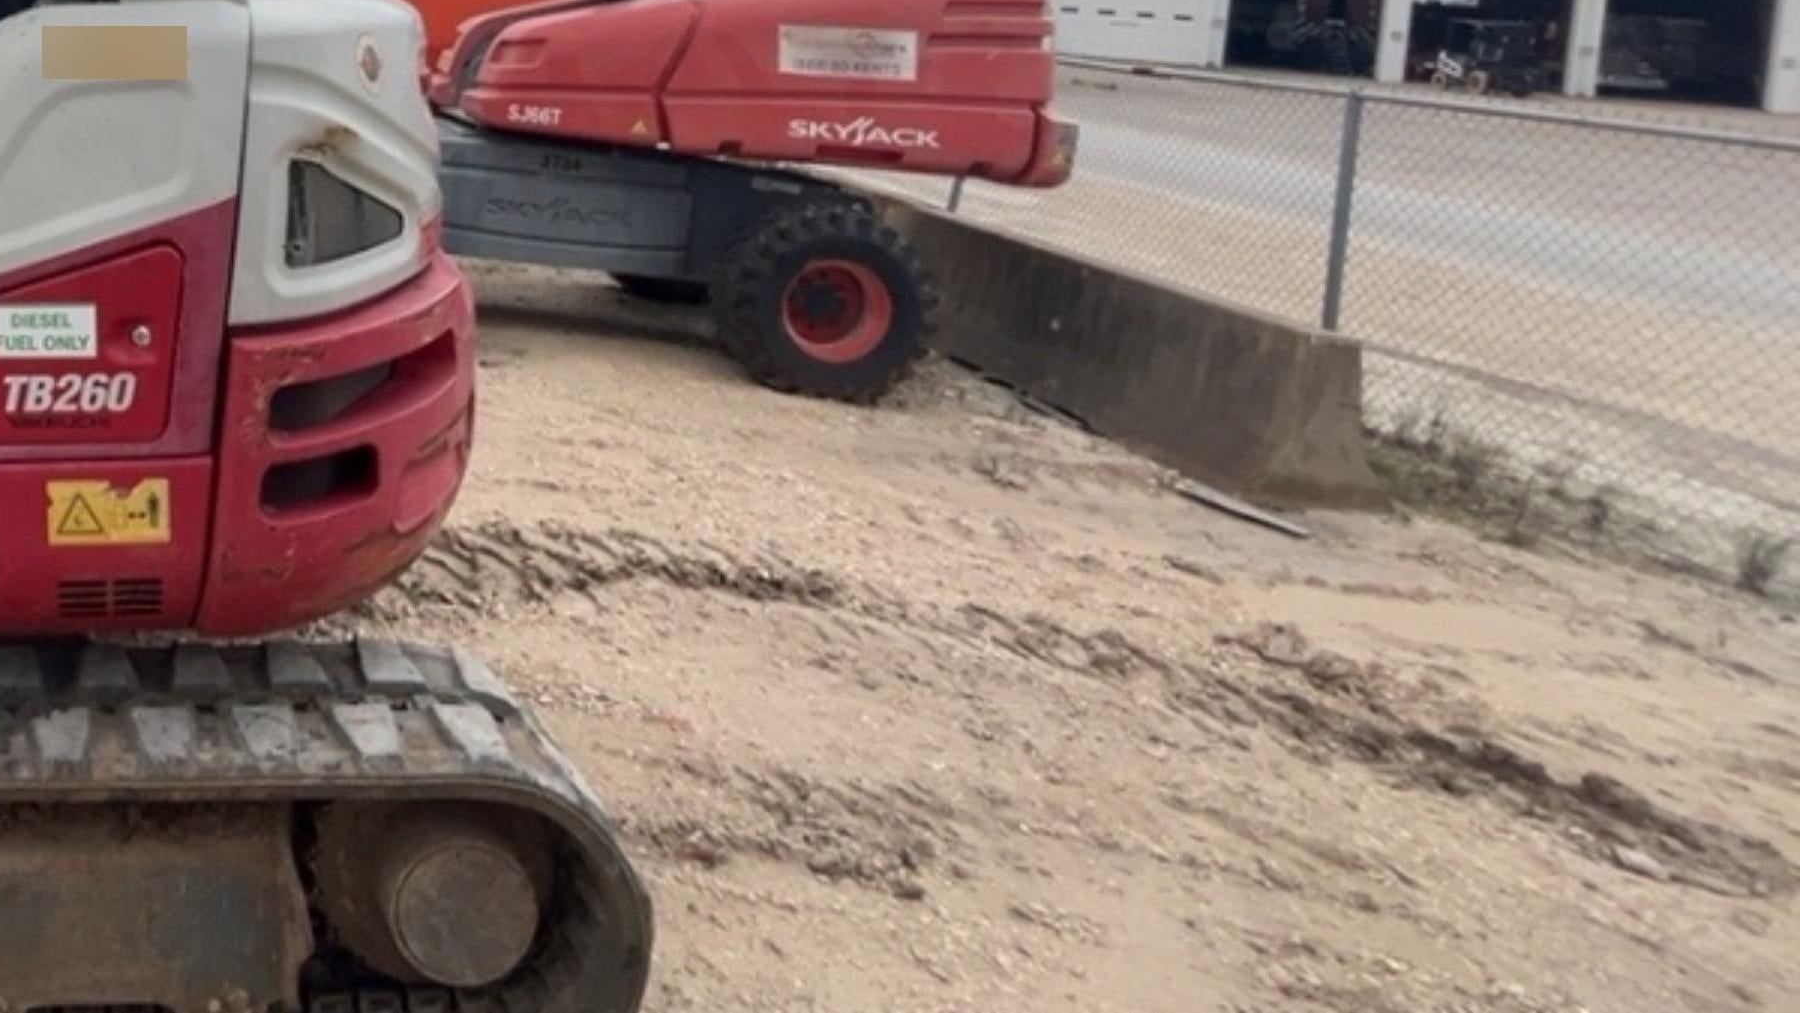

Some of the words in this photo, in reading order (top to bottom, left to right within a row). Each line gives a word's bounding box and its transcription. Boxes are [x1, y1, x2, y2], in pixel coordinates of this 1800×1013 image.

[786, 115, 940, 148] SKYJACK
[10, 312, 72, 329] DIESEL
[43, 334, 90, 351] ONLY
[3, 372, 137, 414] TB260
